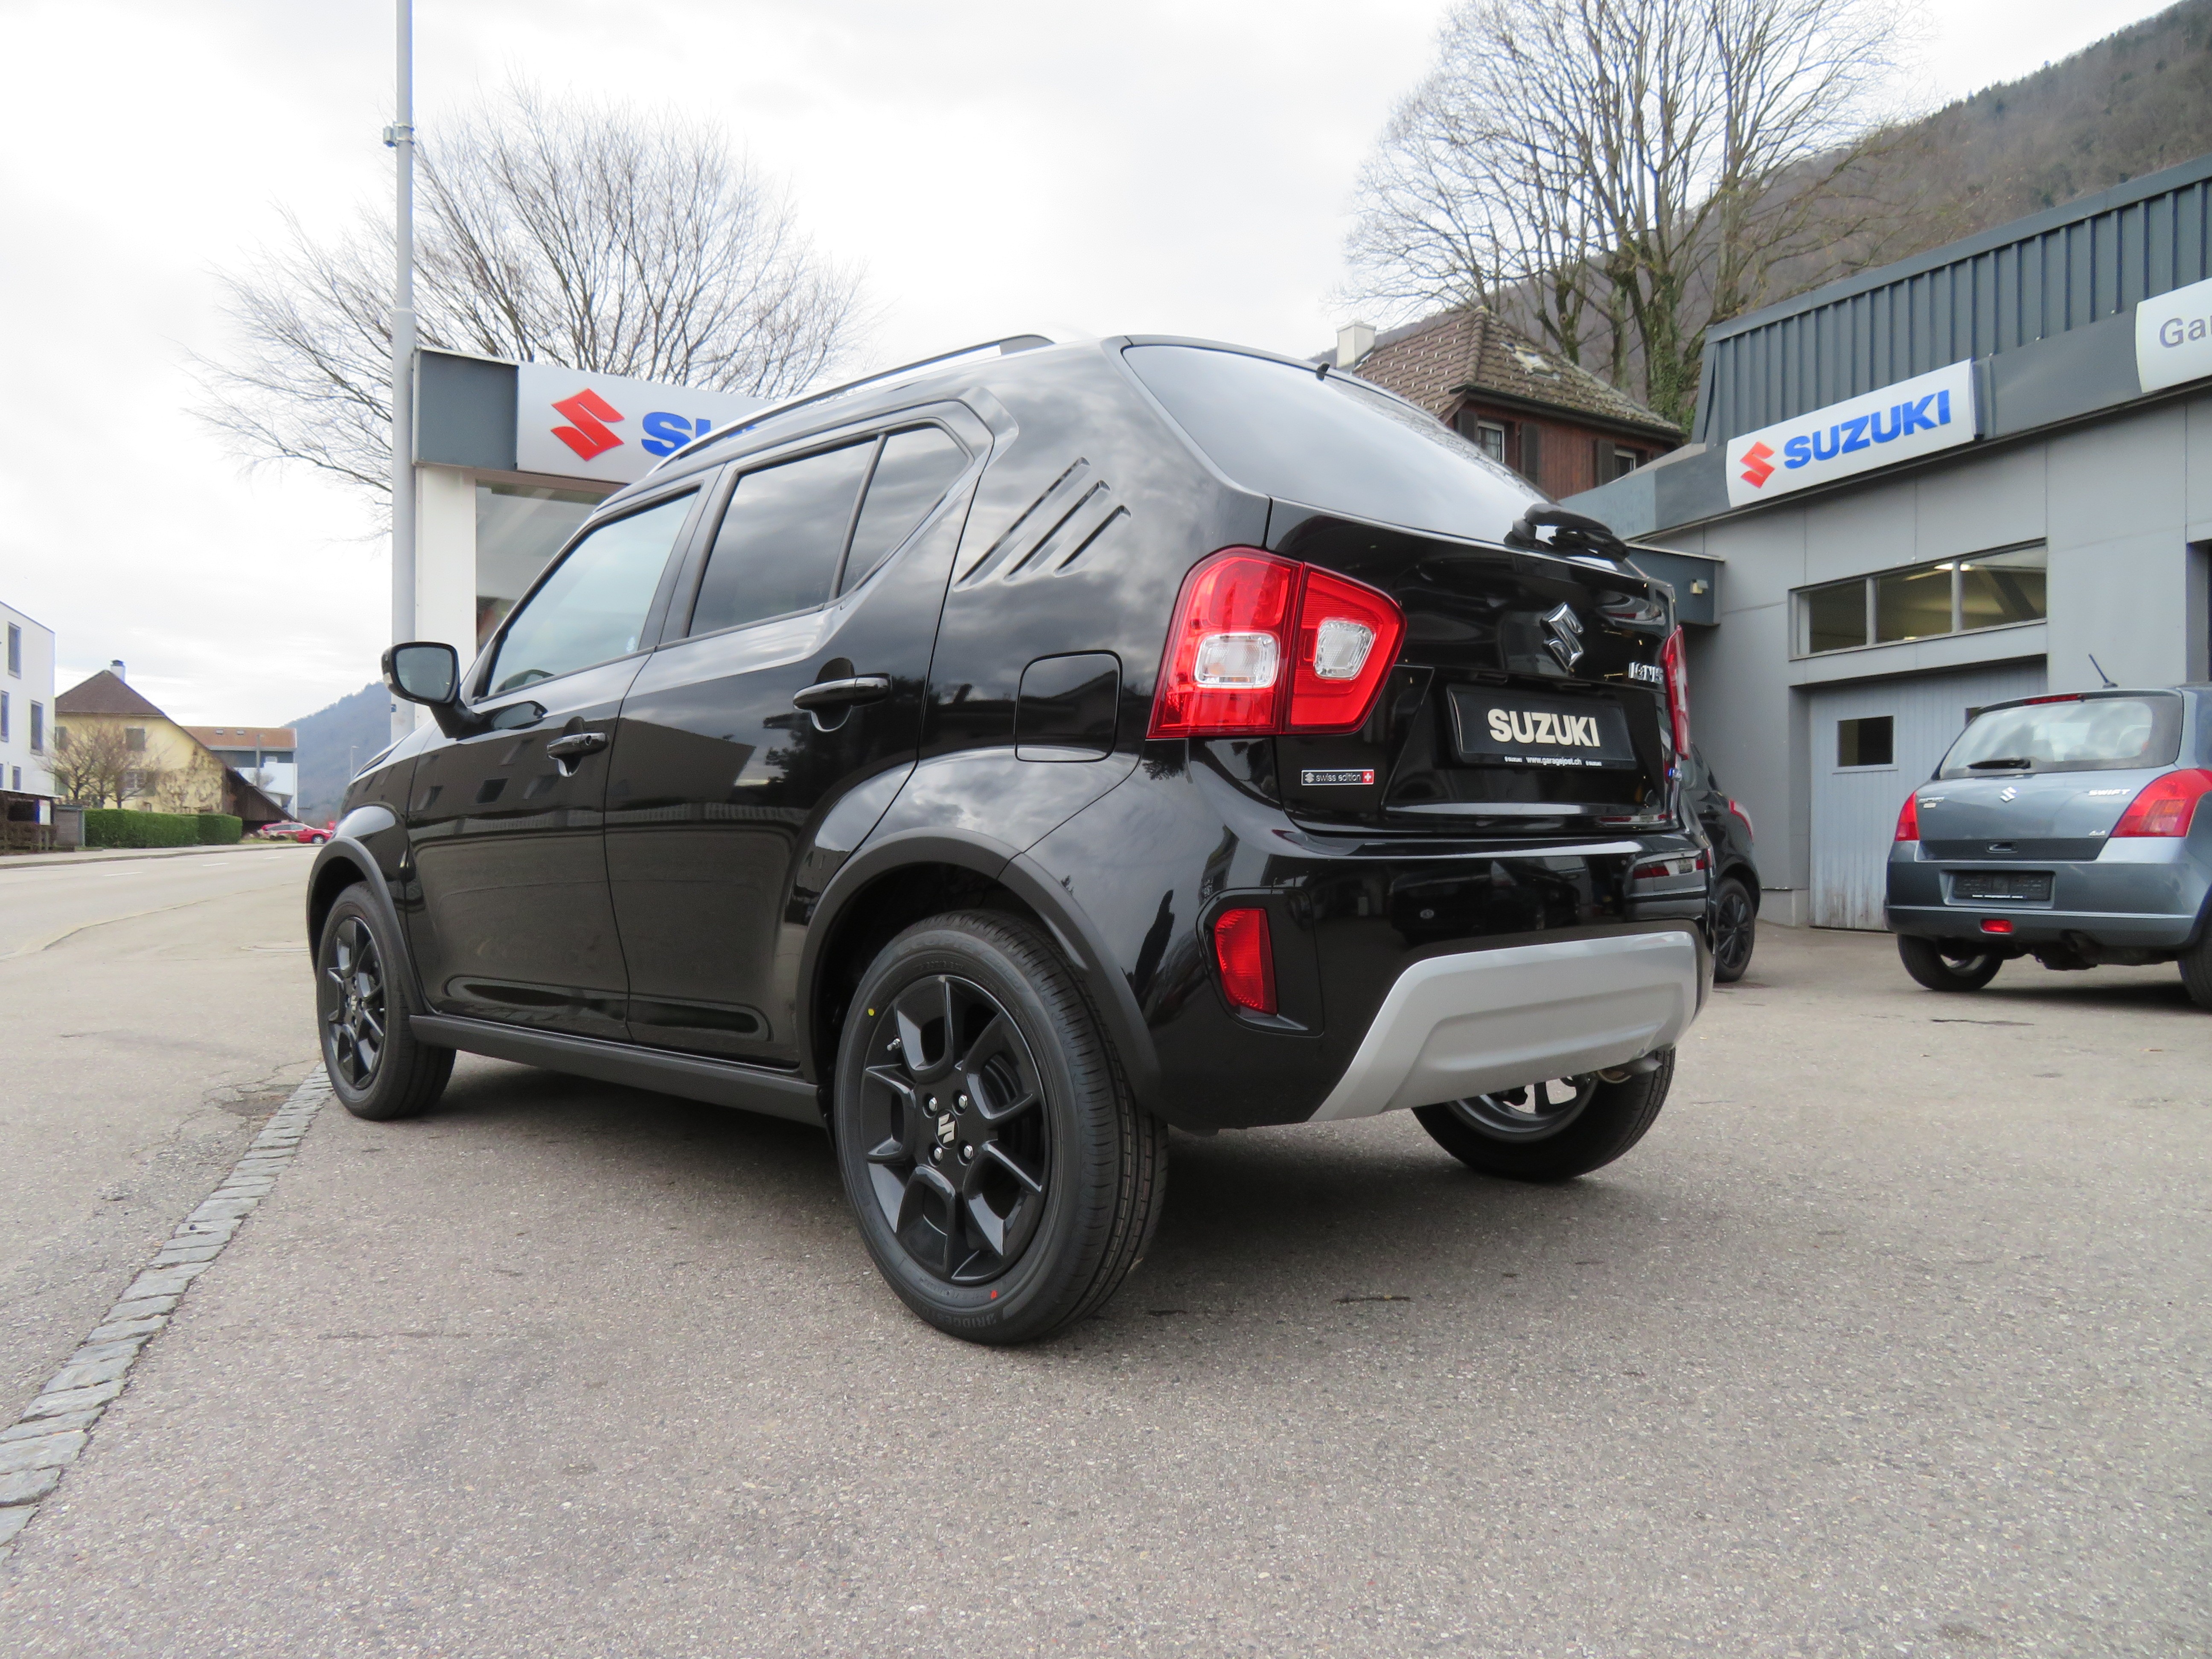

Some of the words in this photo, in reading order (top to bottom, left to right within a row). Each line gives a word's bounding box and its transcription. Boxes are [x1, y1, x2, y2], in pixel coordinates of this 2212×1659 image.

[2159, 315, 2212, 348] Ga
[1784, 389, 1951, 469] SUZUKI
[1487, 709, 1601, 747] SUZUKI
[1316, 773, 1336, 782] swiss
[1338, 773, 1361, 781] edition
[1526, 756, 1582, 766] www.garagejost.ch
